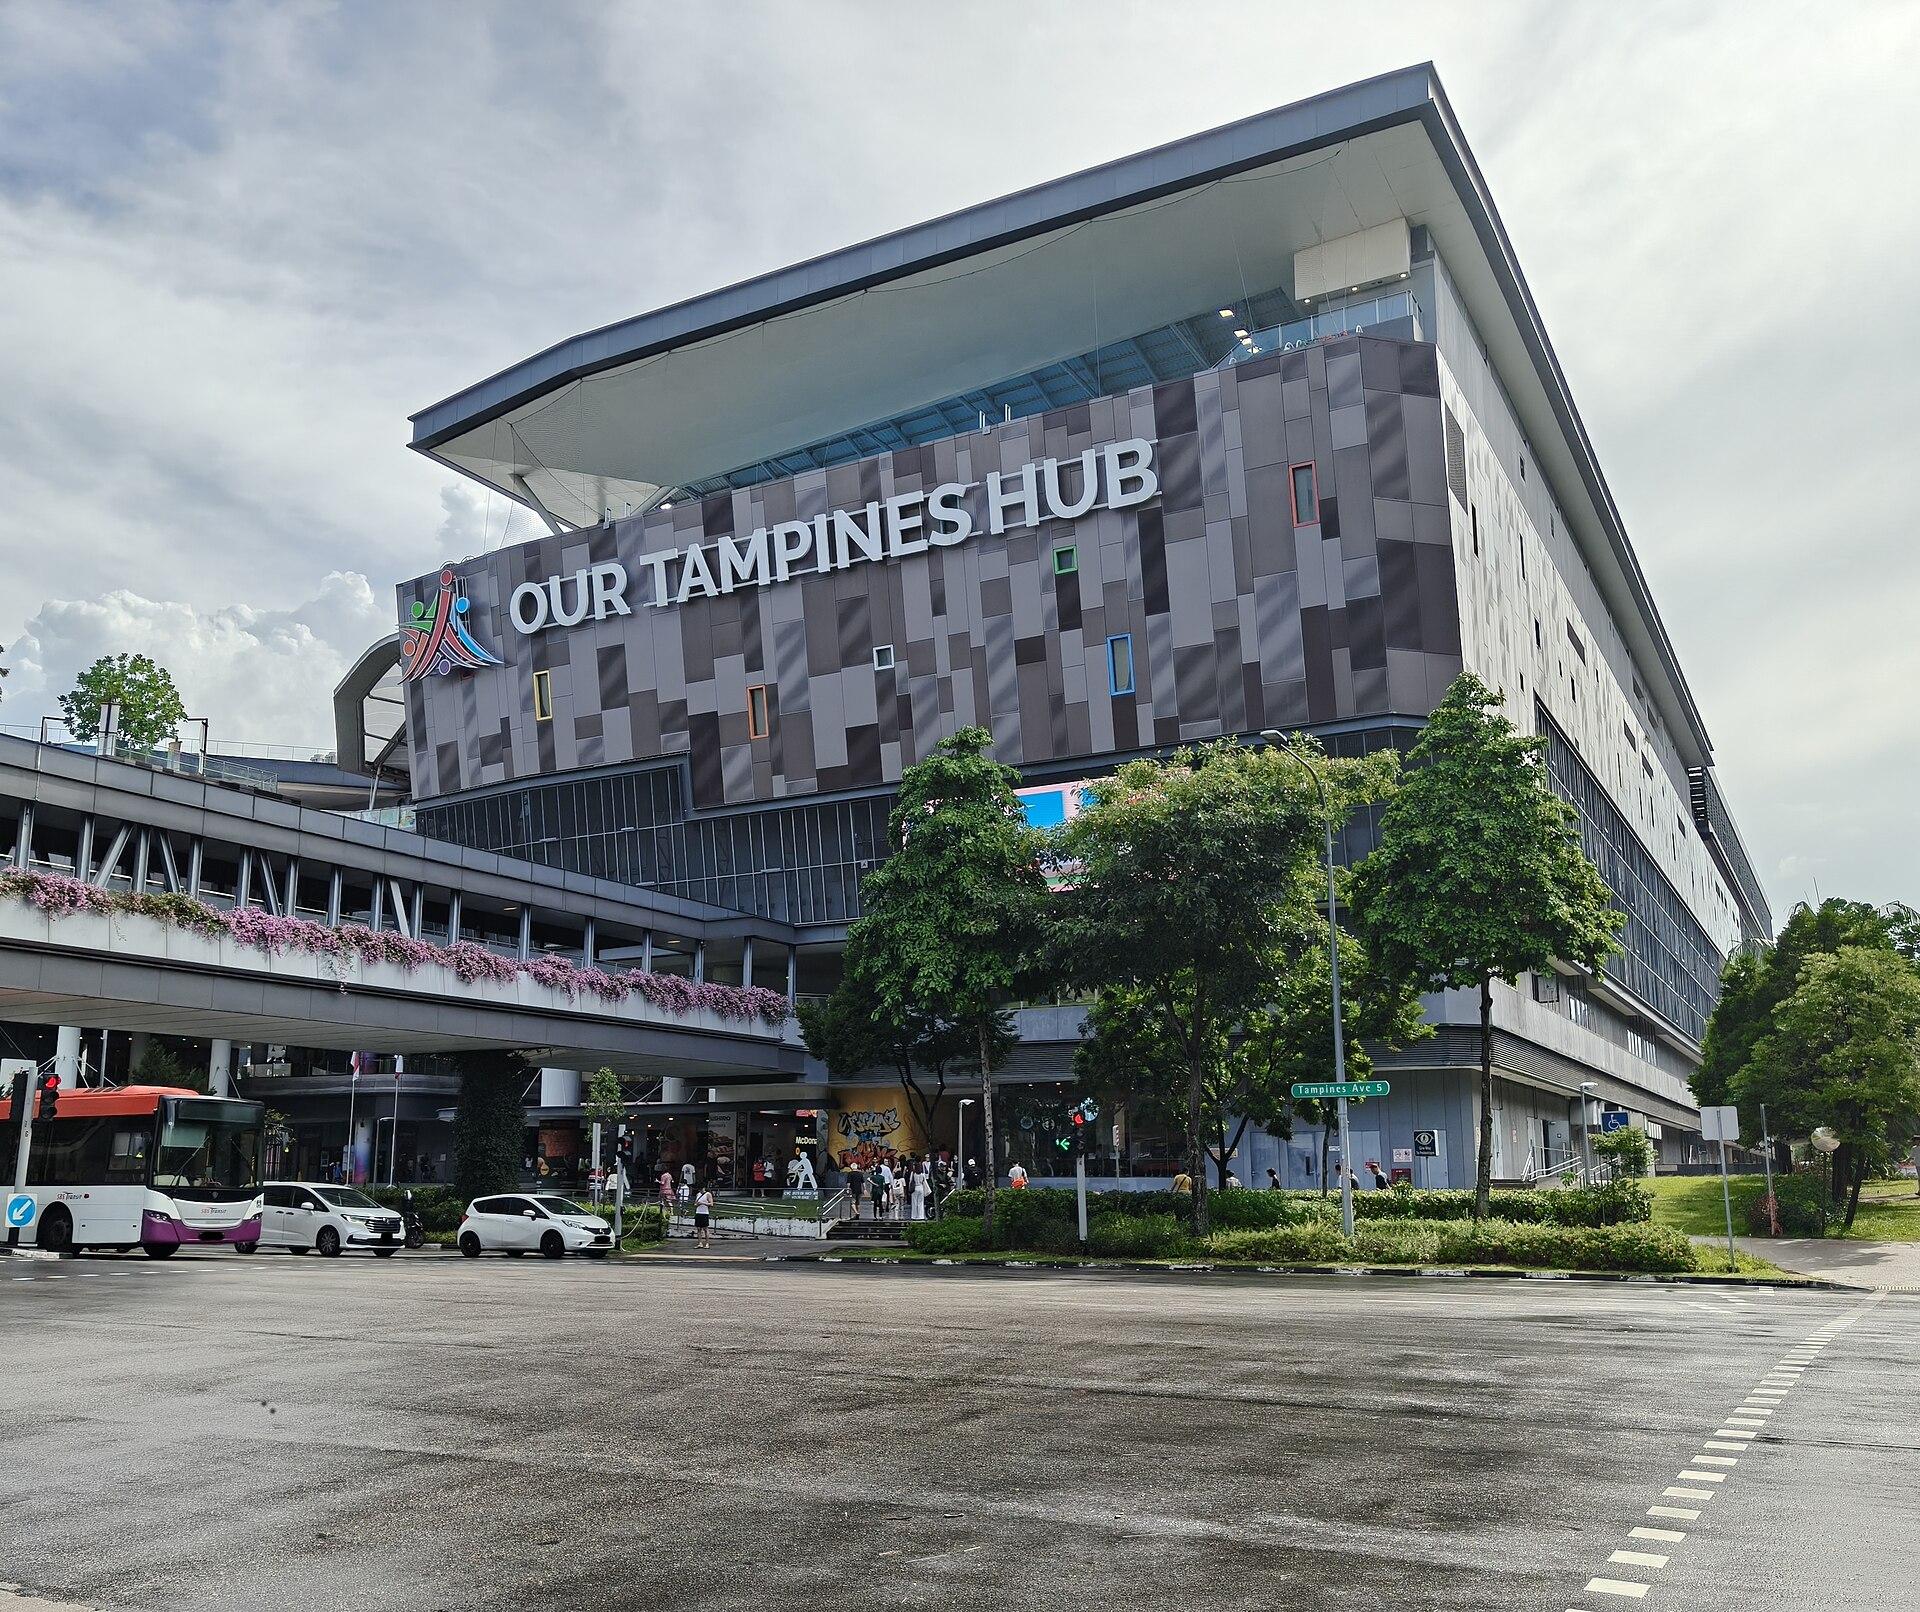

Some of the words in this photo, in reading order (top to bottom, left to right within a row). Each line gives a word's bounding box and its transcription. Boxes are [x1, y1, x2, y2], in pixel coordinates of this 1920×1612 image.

[509, 562, 632, 635] OUR
[639, 483, 974, 608] TAMPINES
[987, 437, 1160, 533] HUB
[1298, 1085, 1347, 1095] Tampines
[1352, 1084, 1371, 1093] Ave
[1377, 1084, 1382, 1092] 5
